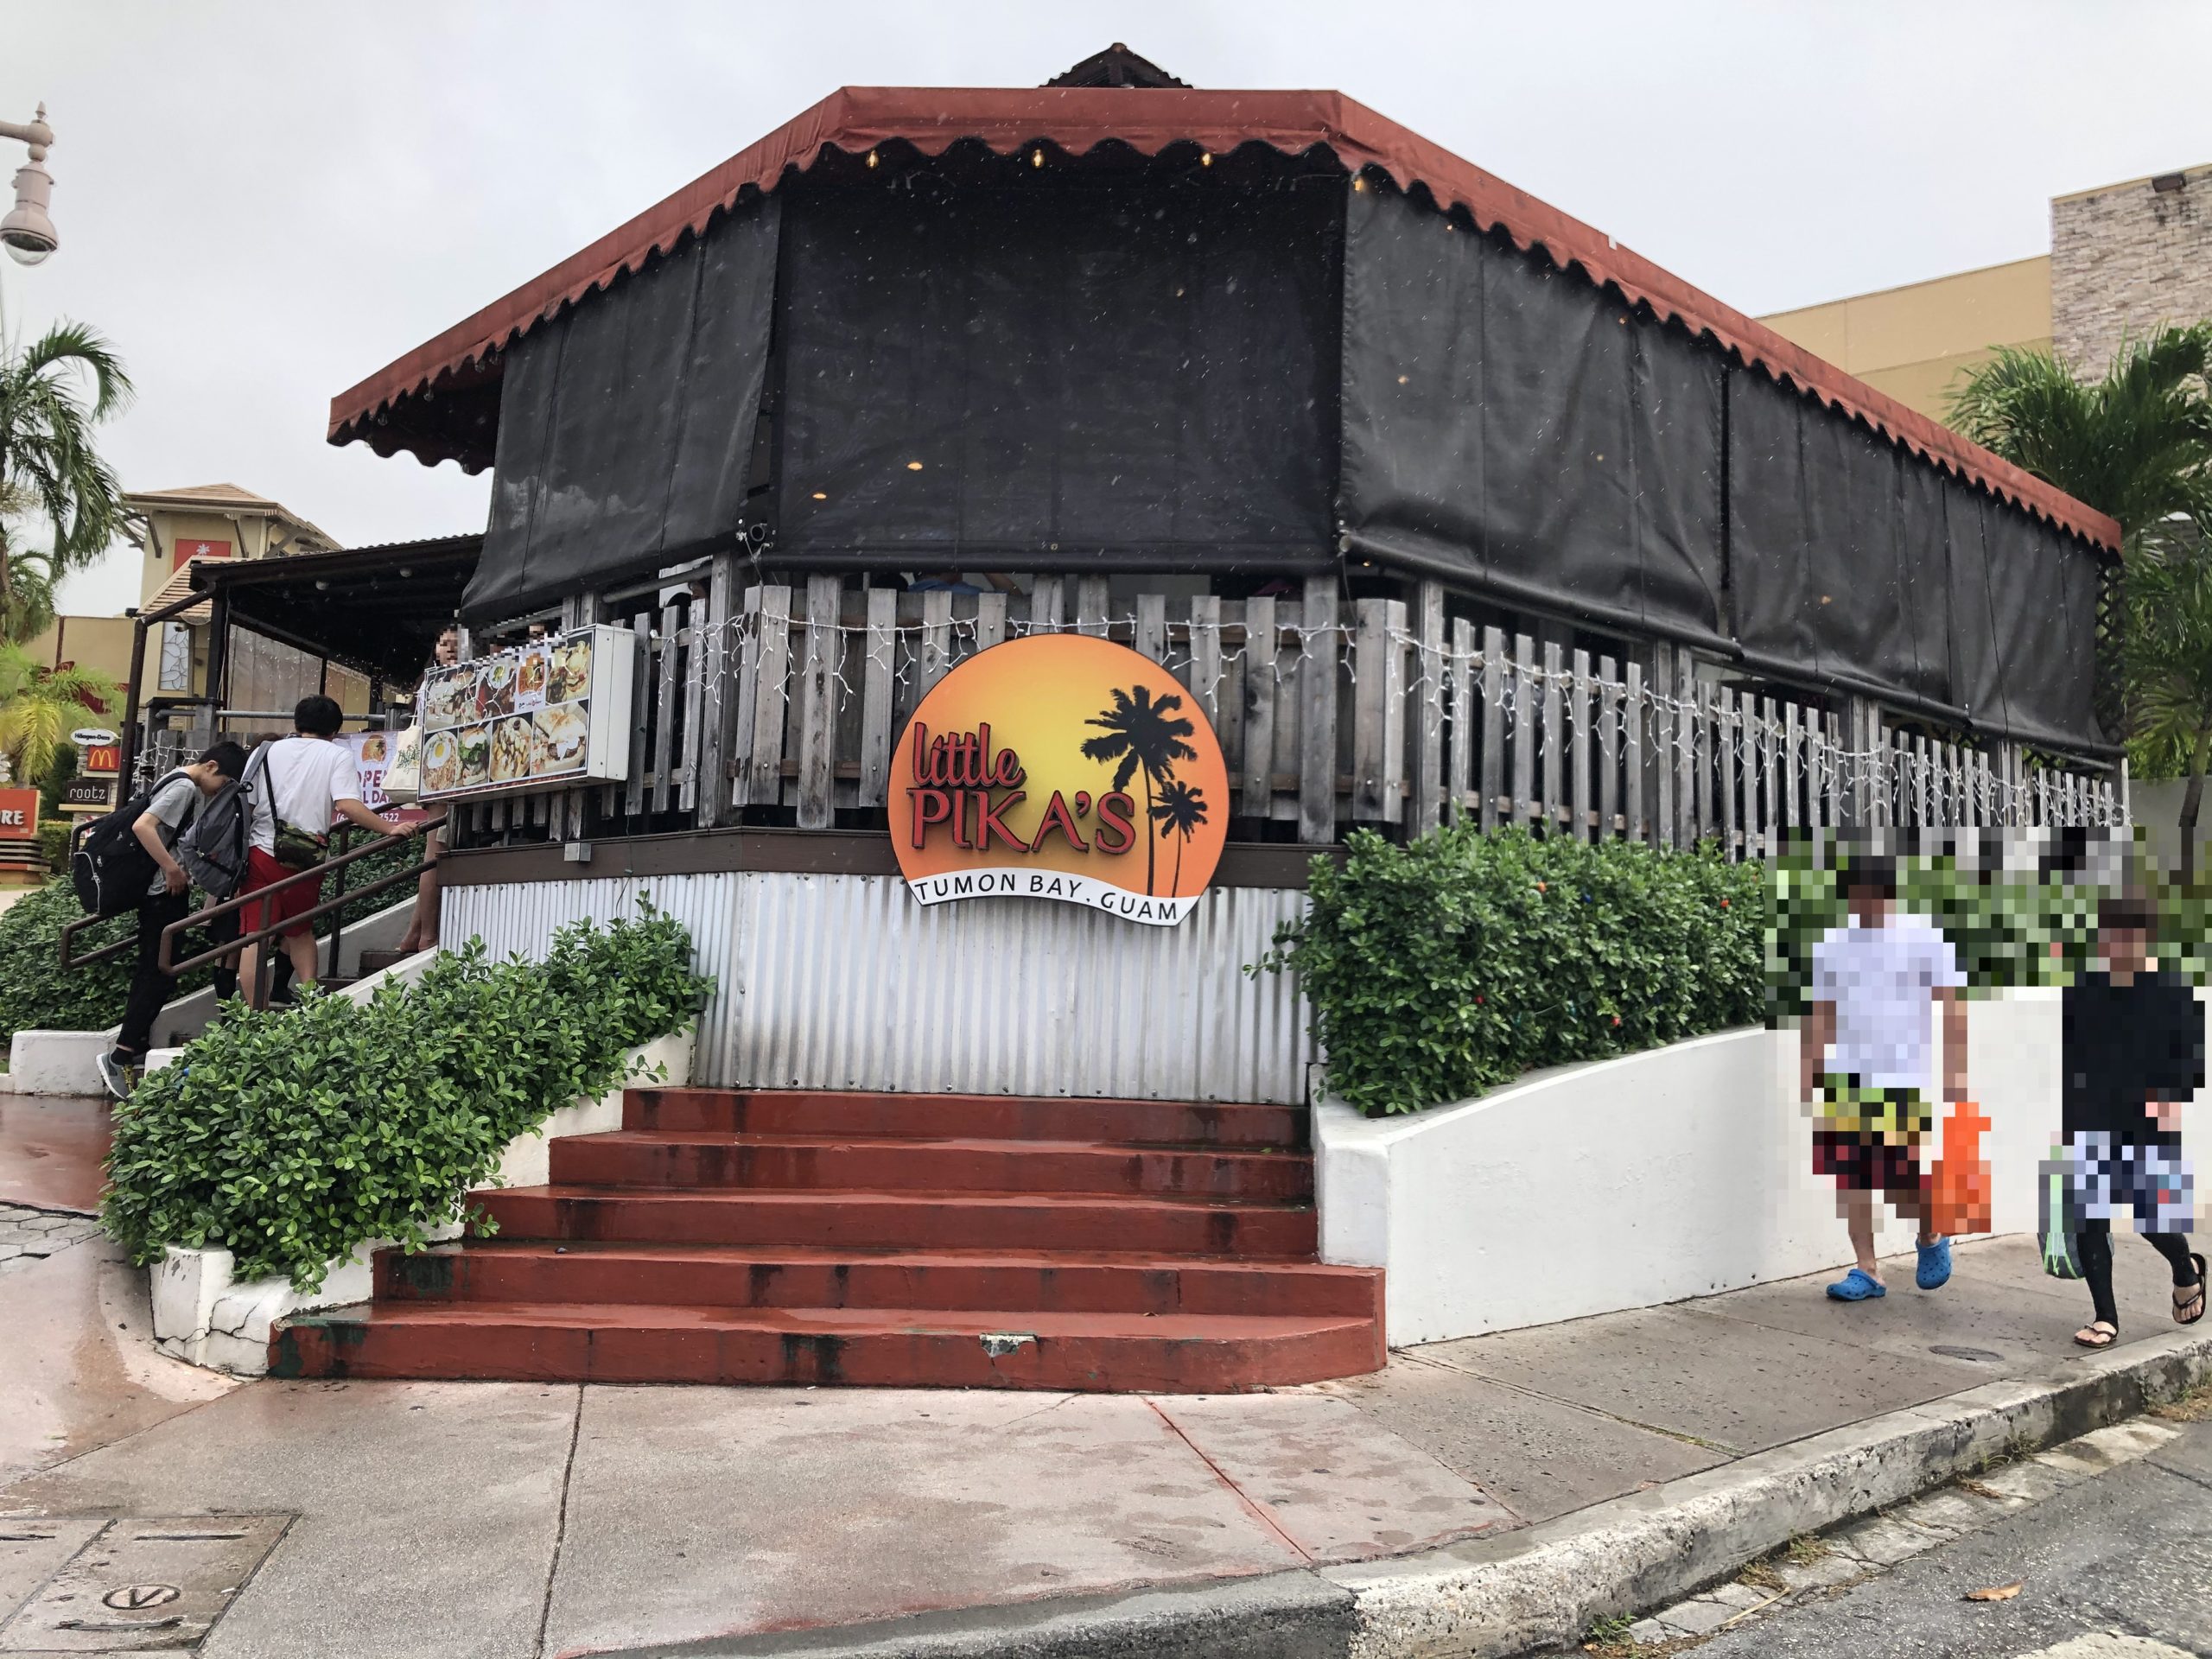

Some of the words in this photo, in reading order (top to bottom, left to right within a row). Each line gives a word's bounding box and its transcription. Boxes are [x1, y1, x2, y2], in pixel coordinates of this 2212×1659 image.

[912, 722, 1027, 787] little
[69, 785, 105, 799] rootz
[906, 787, 1136, 855] PIKA'S
[913, 874, 1016, 901] TUMON
[1100, 892, 1178, 921] GUAM
